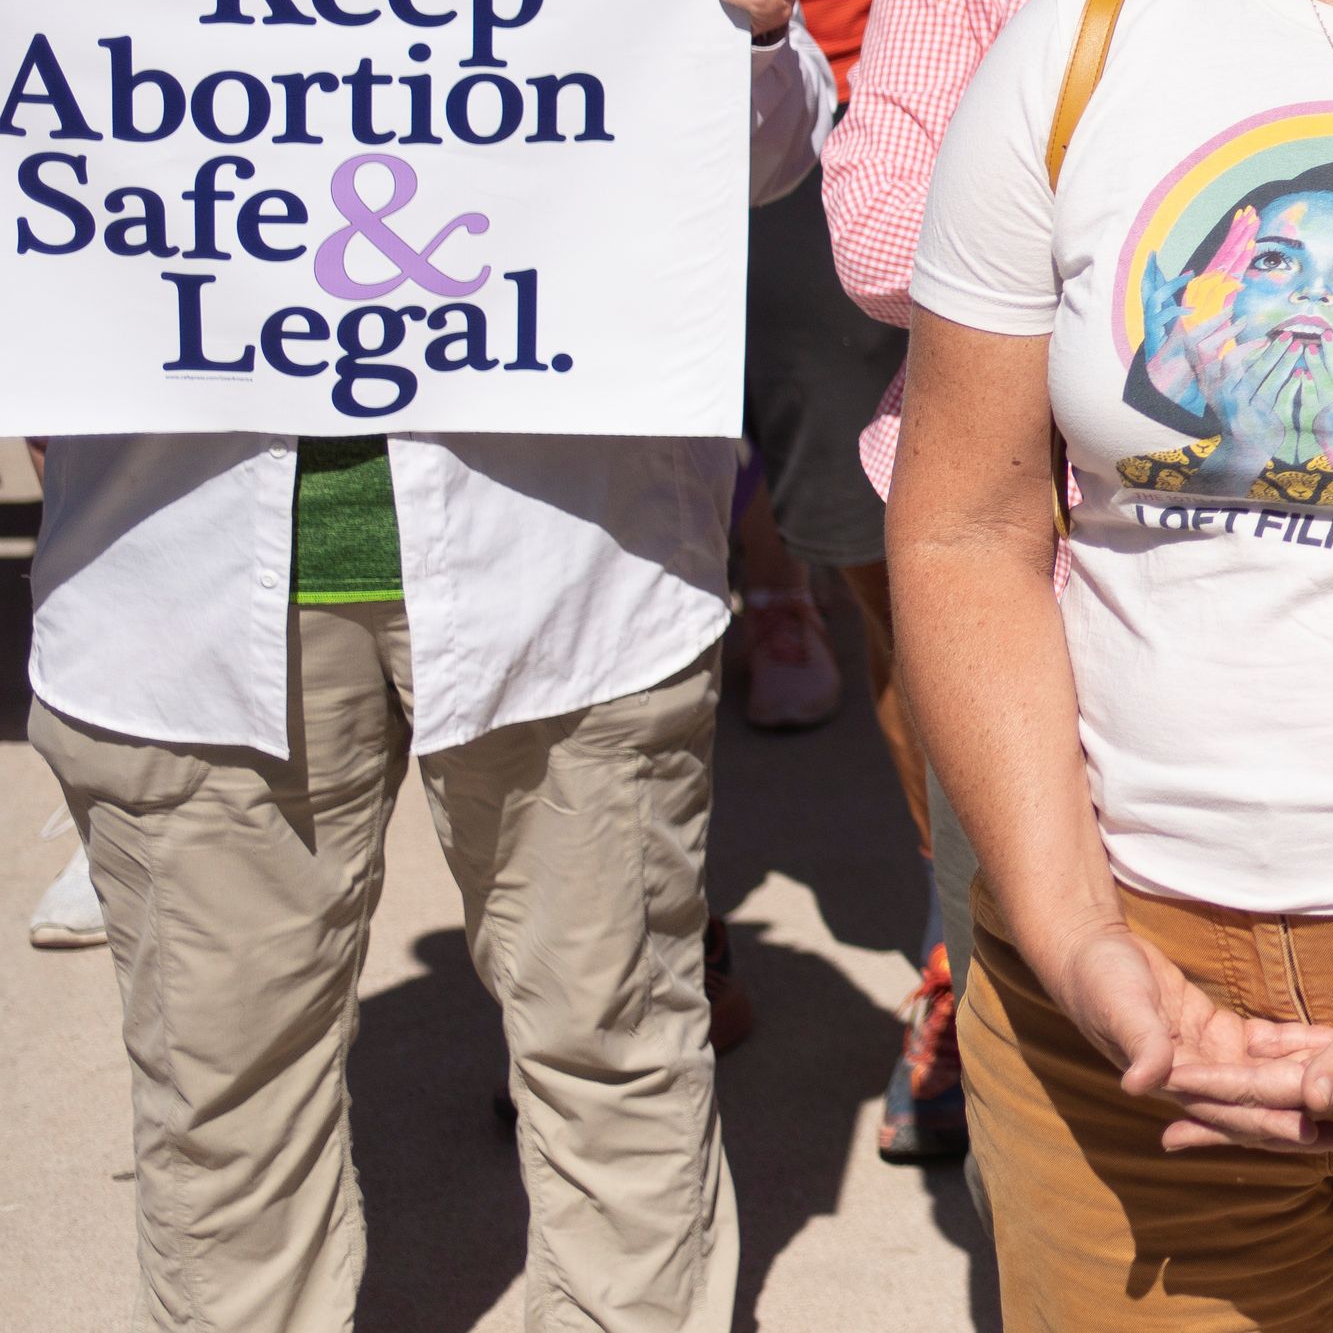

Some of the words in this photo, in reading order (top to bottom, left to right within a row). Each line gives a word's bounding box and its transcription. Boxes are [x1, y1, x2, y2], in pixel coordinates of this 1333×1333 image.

[0, 32, 615, 146] Abortion
[16, 151, 309, 262] Safe
[313, 153, 491, 301] &
[160, 268, 574, 419] Legal.
